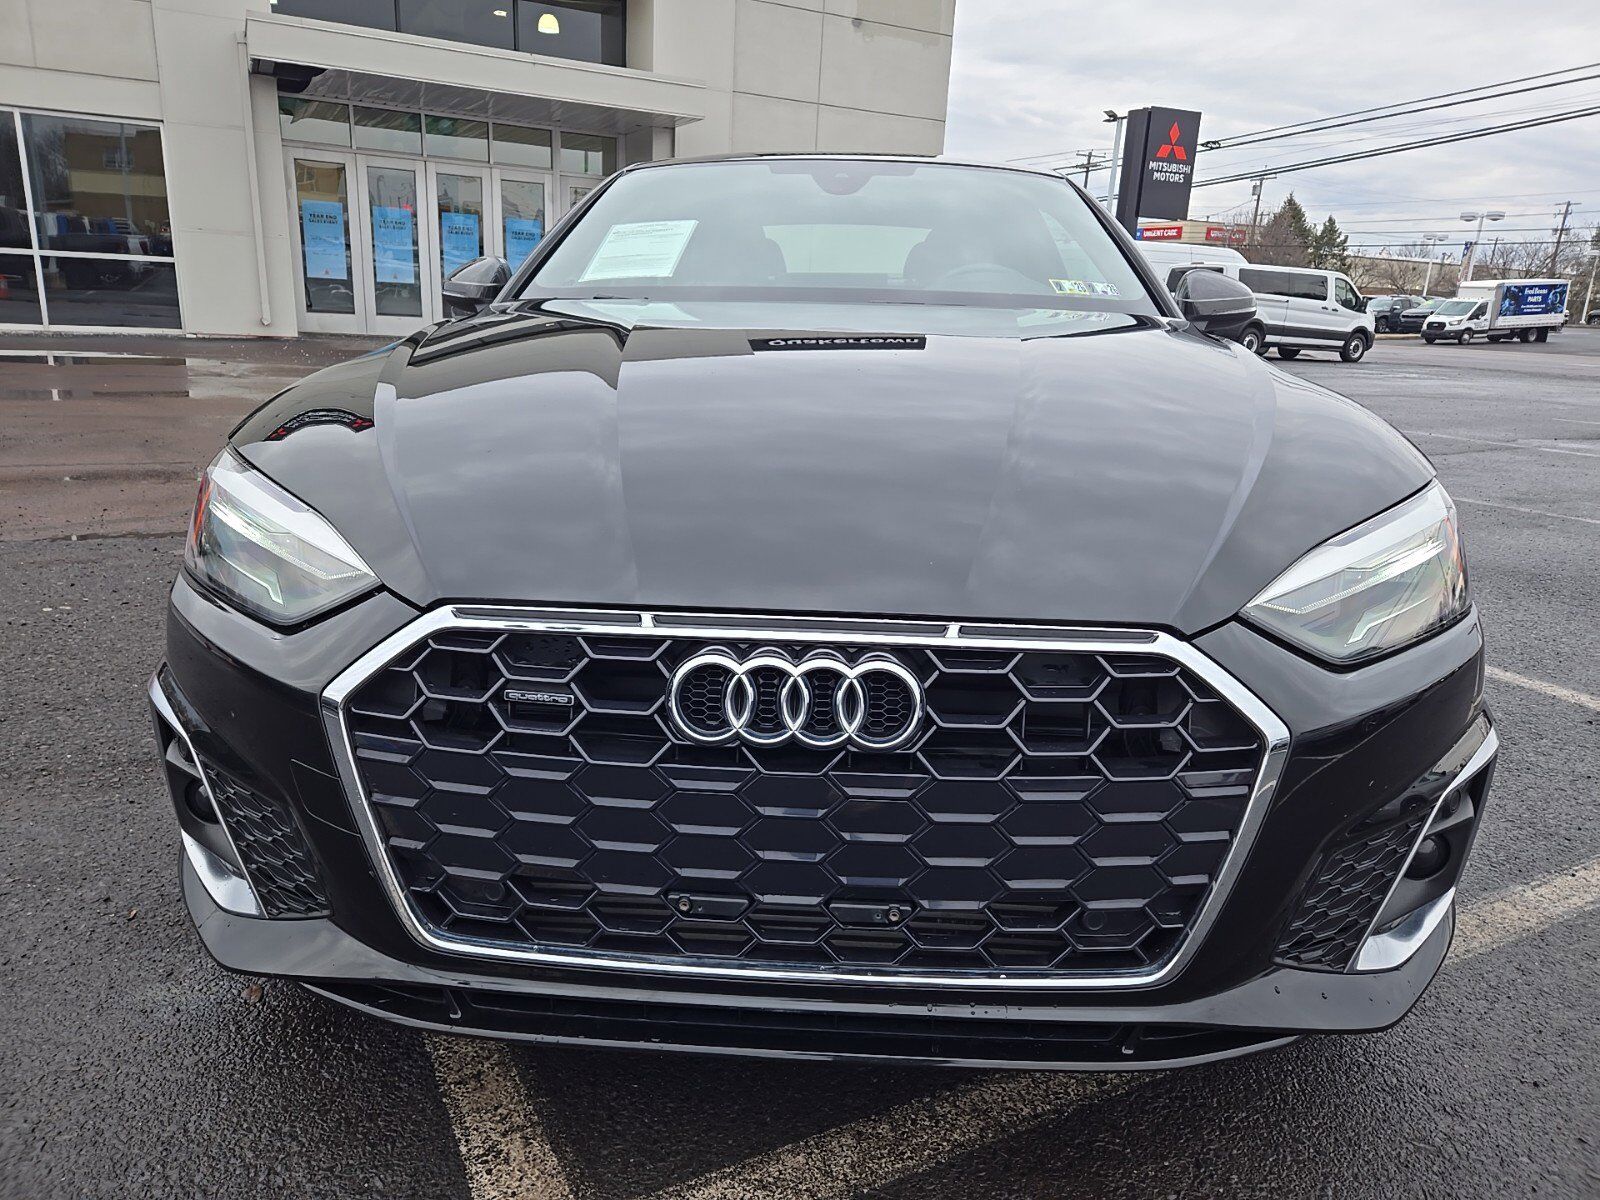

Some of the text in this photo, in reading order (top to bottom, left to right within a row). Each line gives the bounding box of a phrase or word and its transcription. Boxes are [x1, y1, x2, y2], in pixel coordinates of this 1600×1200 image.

[1149, 161, 1191, 174] MITSUBISHI
[1153, 172, 1184, 183] MOTORS
[1143, 229, 1164, 237] URGENT
[508, 692, 568, 703] quattro
